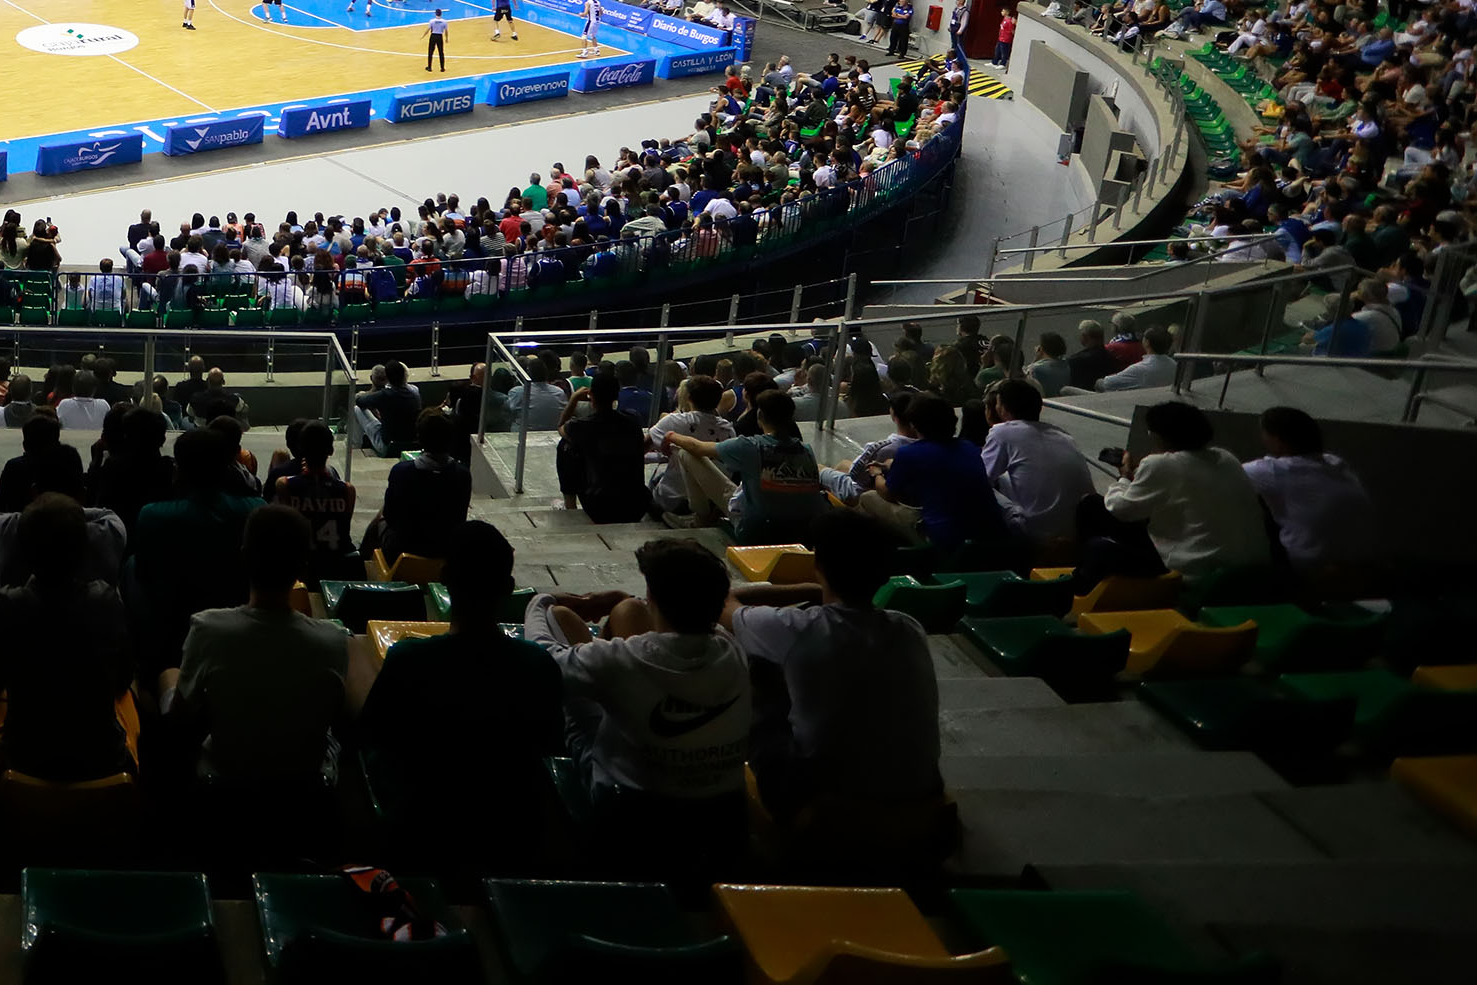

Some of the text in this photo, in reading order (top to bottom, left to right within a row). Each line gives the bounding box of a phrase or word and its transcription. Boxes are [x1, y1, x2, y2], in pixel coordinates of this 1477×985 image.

[652, 18, 720, 45] Diario de Burgos
[672, 57, 705, 68] CASTILLA
[708, 56, 714, 65] Y
[515, 80, 567, 98] prevennova
[400, 95, 471, 118] KOMTES
[306, 107, 352, 131] Avnt.
[291, 497, 348, 512] DAVID
